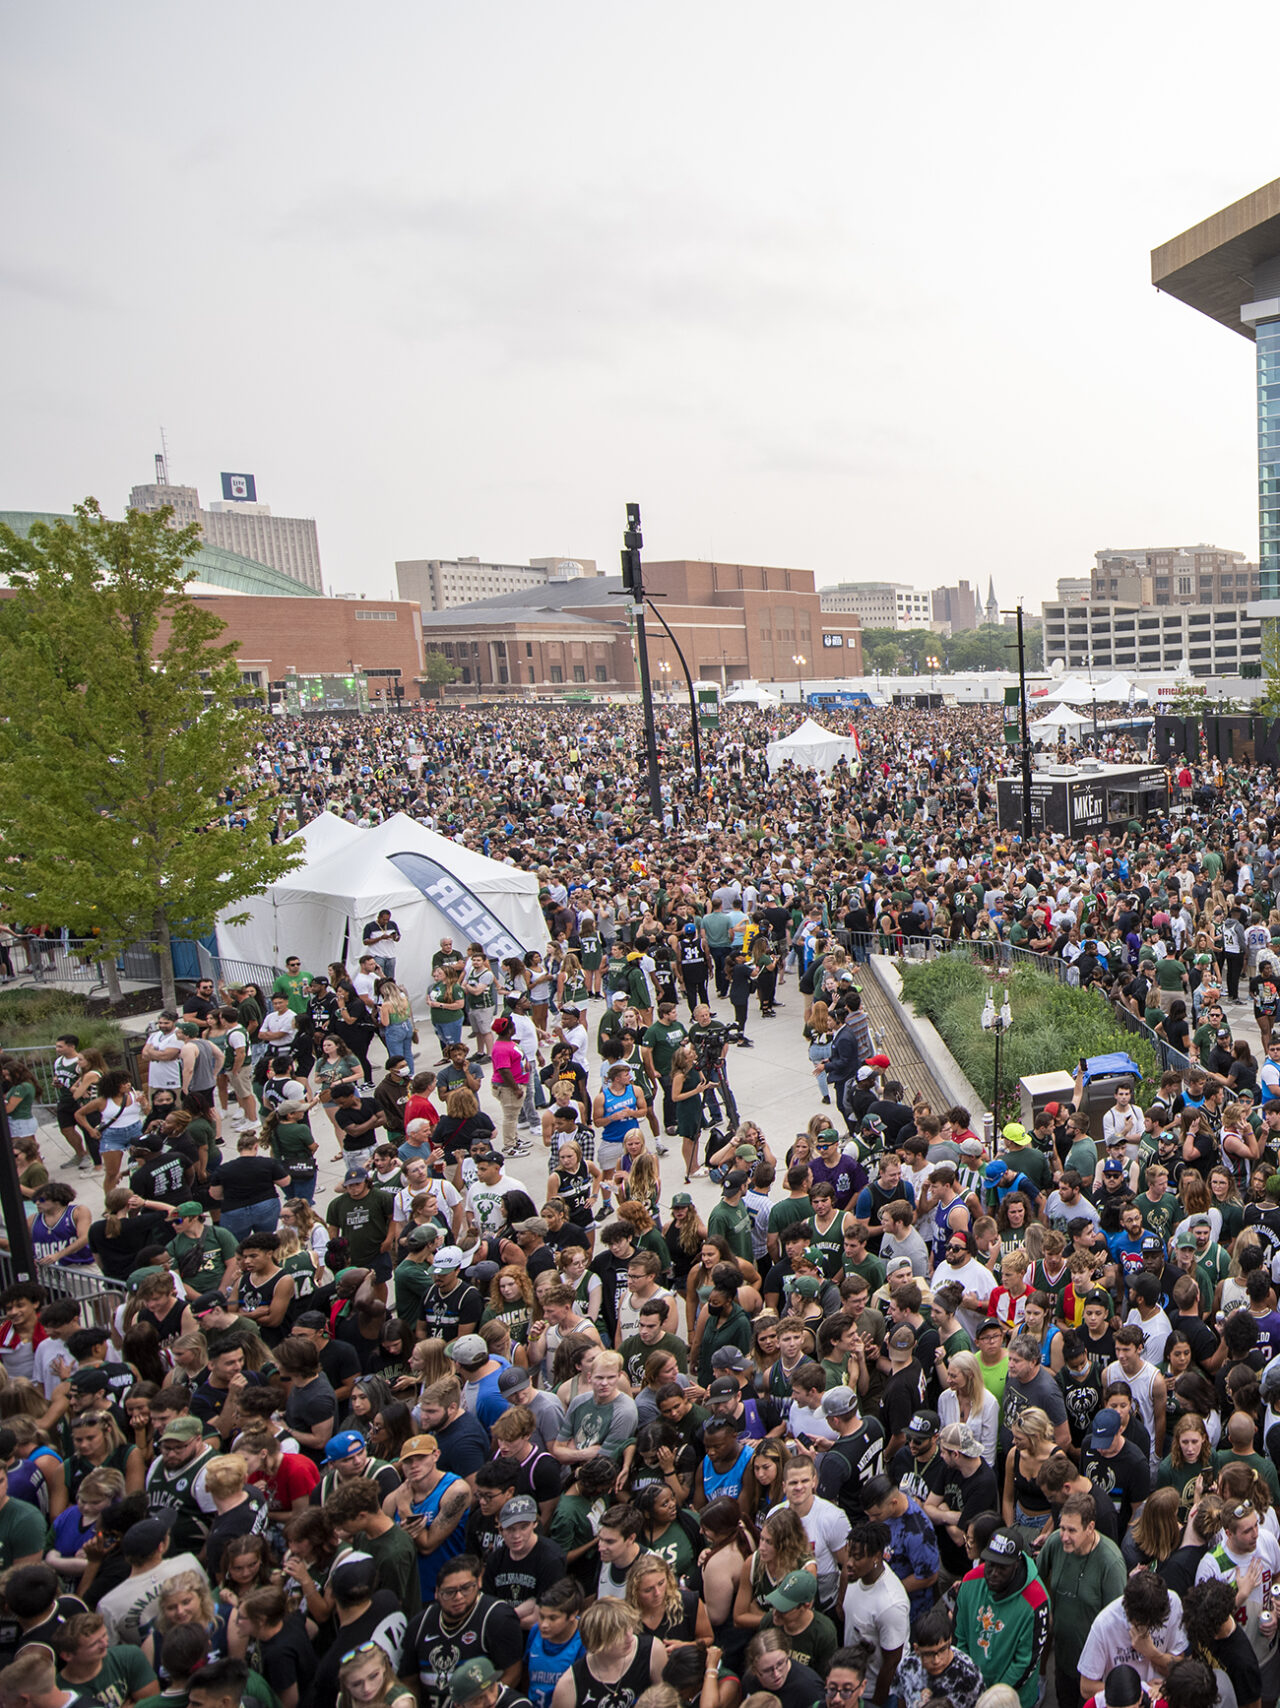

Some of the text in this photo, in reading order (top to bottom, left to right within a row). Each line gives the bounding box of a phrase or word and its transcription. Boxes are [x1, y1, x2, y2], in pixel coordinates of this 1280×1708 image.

[1249, 934, 1265, 946] 34
[684, 946, 700, 959] 34
[574, 1198, 587, 1210] 34
[294, 1276, 314, 1300] 14
